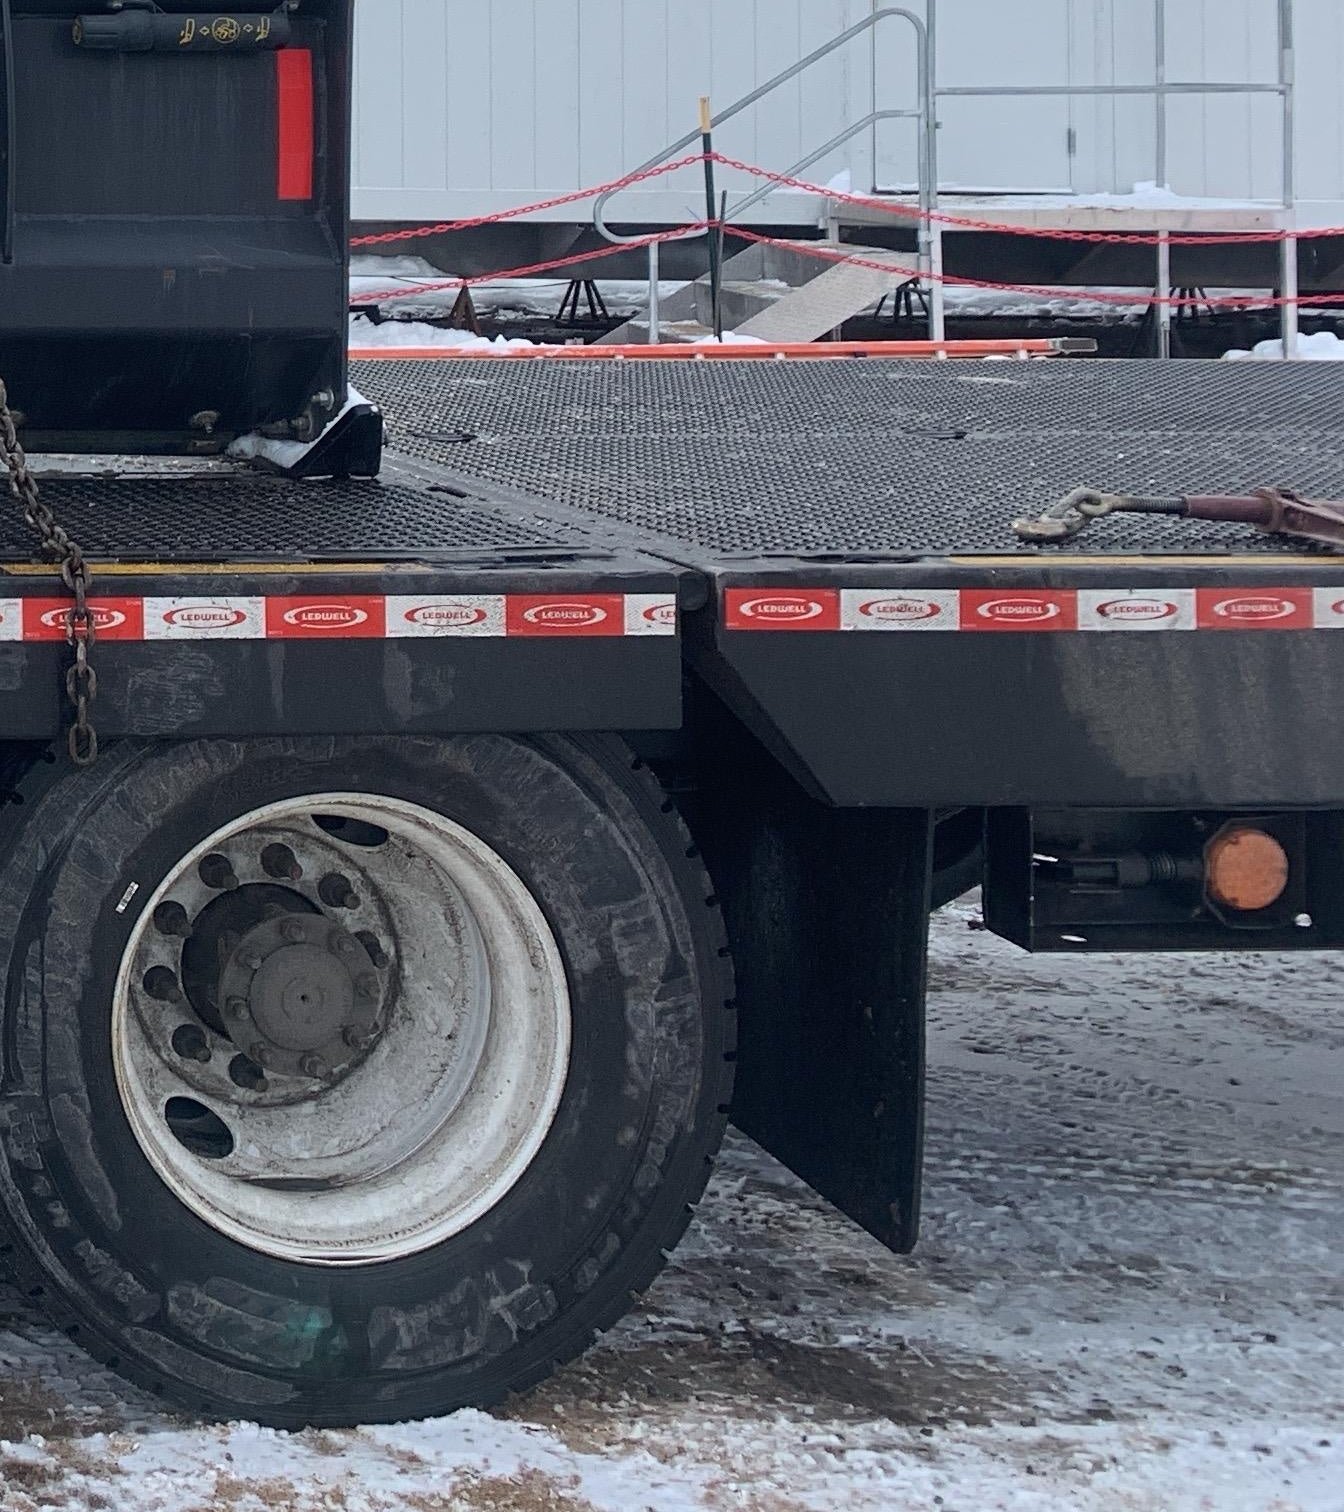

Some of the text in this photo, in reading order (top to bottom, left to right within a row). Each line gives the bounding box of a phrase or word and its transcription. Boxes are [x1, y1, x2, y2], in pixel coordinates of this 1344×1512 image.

[757, 603, 806, 614] LEDWELL
[995, 604, 1044, 615] LEDWELL
[181, 613, 231, 622] LEDWELL
[301, 611, 354, 621] LEDWELL
